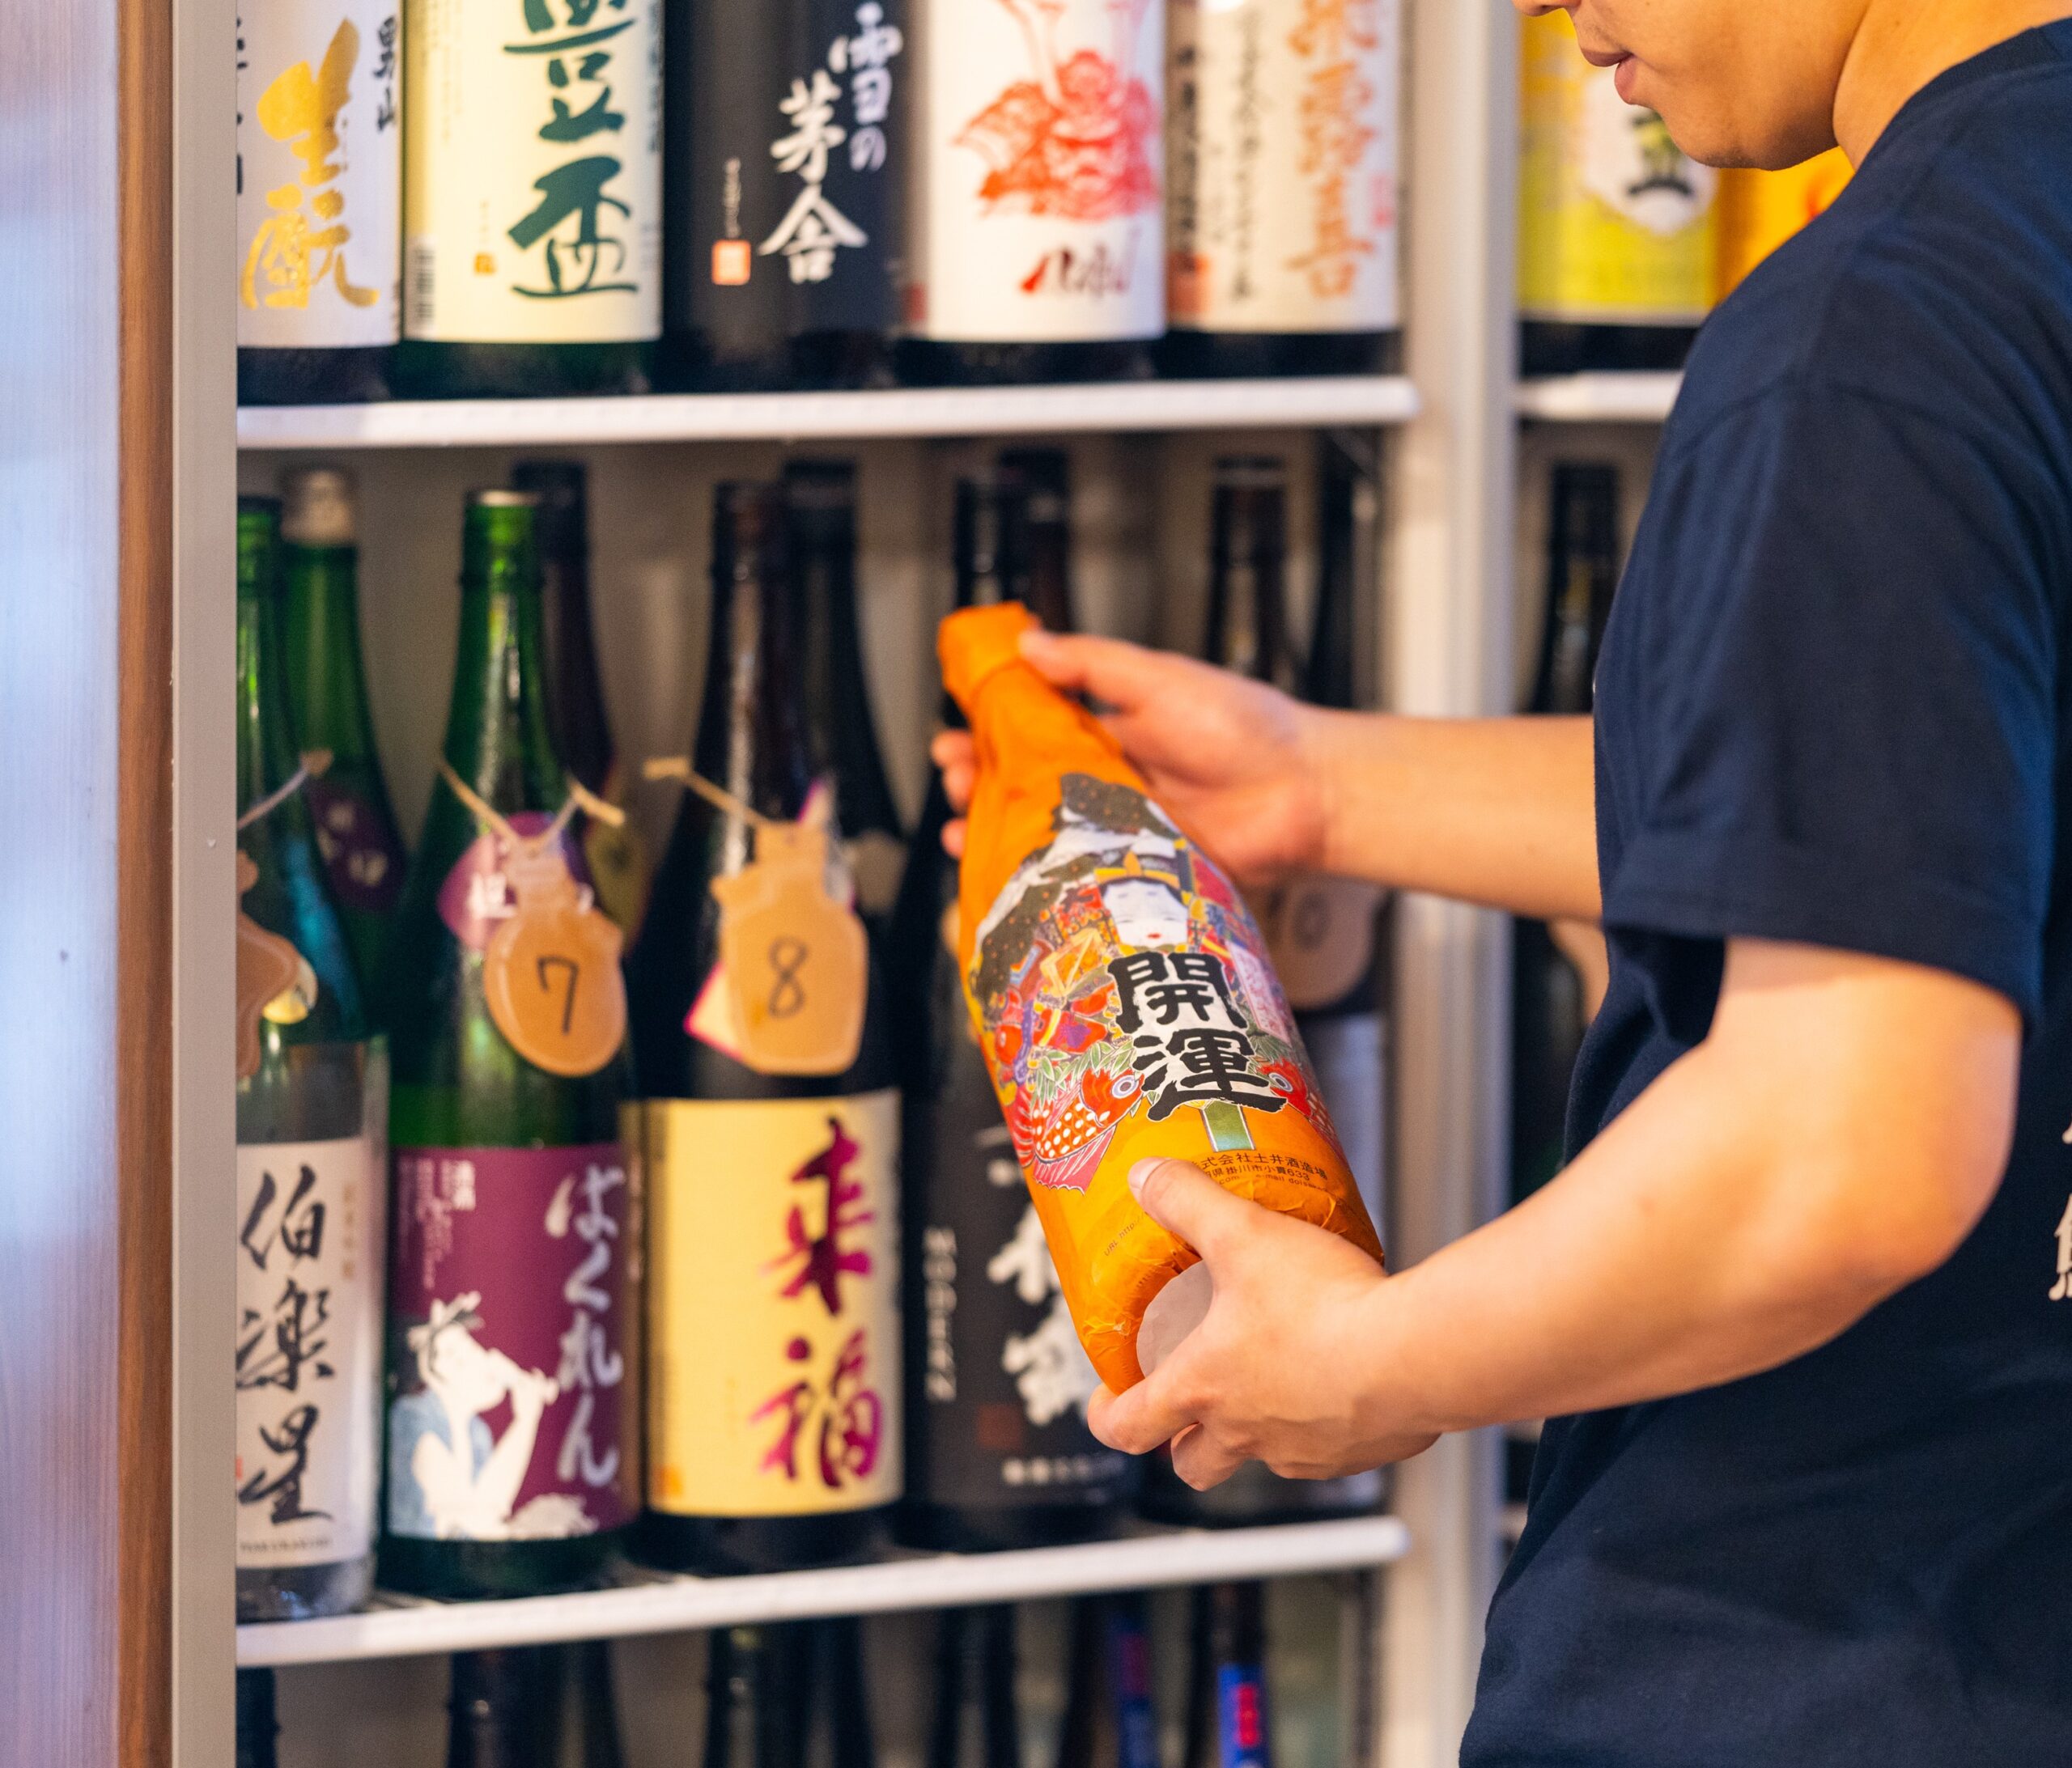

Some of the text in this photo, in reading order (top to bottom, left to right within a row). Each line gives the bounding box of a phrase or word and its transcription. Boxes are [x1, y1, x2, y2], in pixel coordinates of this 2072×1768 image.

[537, 955, 580, 1037] 7
[767, 935, 808, 1020] 8
[1106, 950, 1288, 1122] 開運
[1194, 1151, 1328, 1181] 式会社土井酒造場
